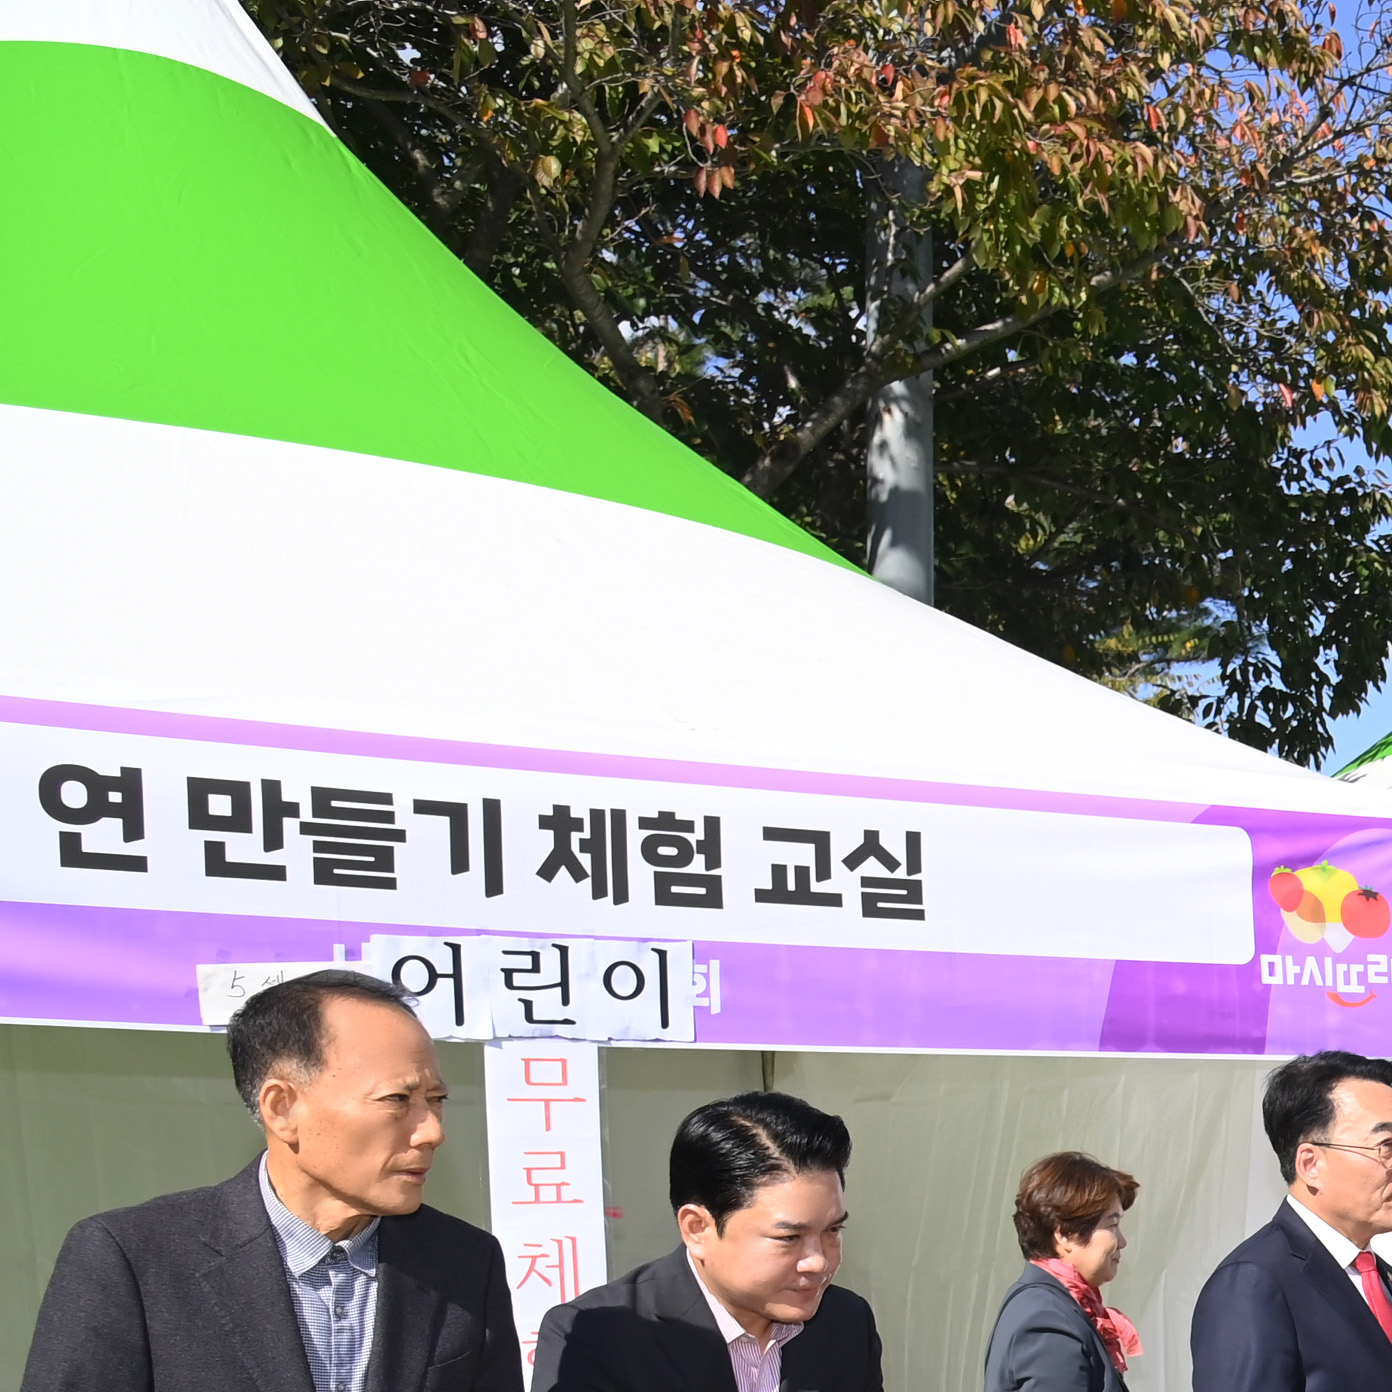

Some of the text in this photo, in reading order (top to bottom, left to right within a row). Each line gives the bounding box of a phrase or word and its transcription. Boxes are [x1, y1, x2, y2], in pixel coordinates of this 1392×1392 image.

[39, 763, 926, 921] 연 만들기 체험 교실
[391, 941, 670, 1031] 어린이
